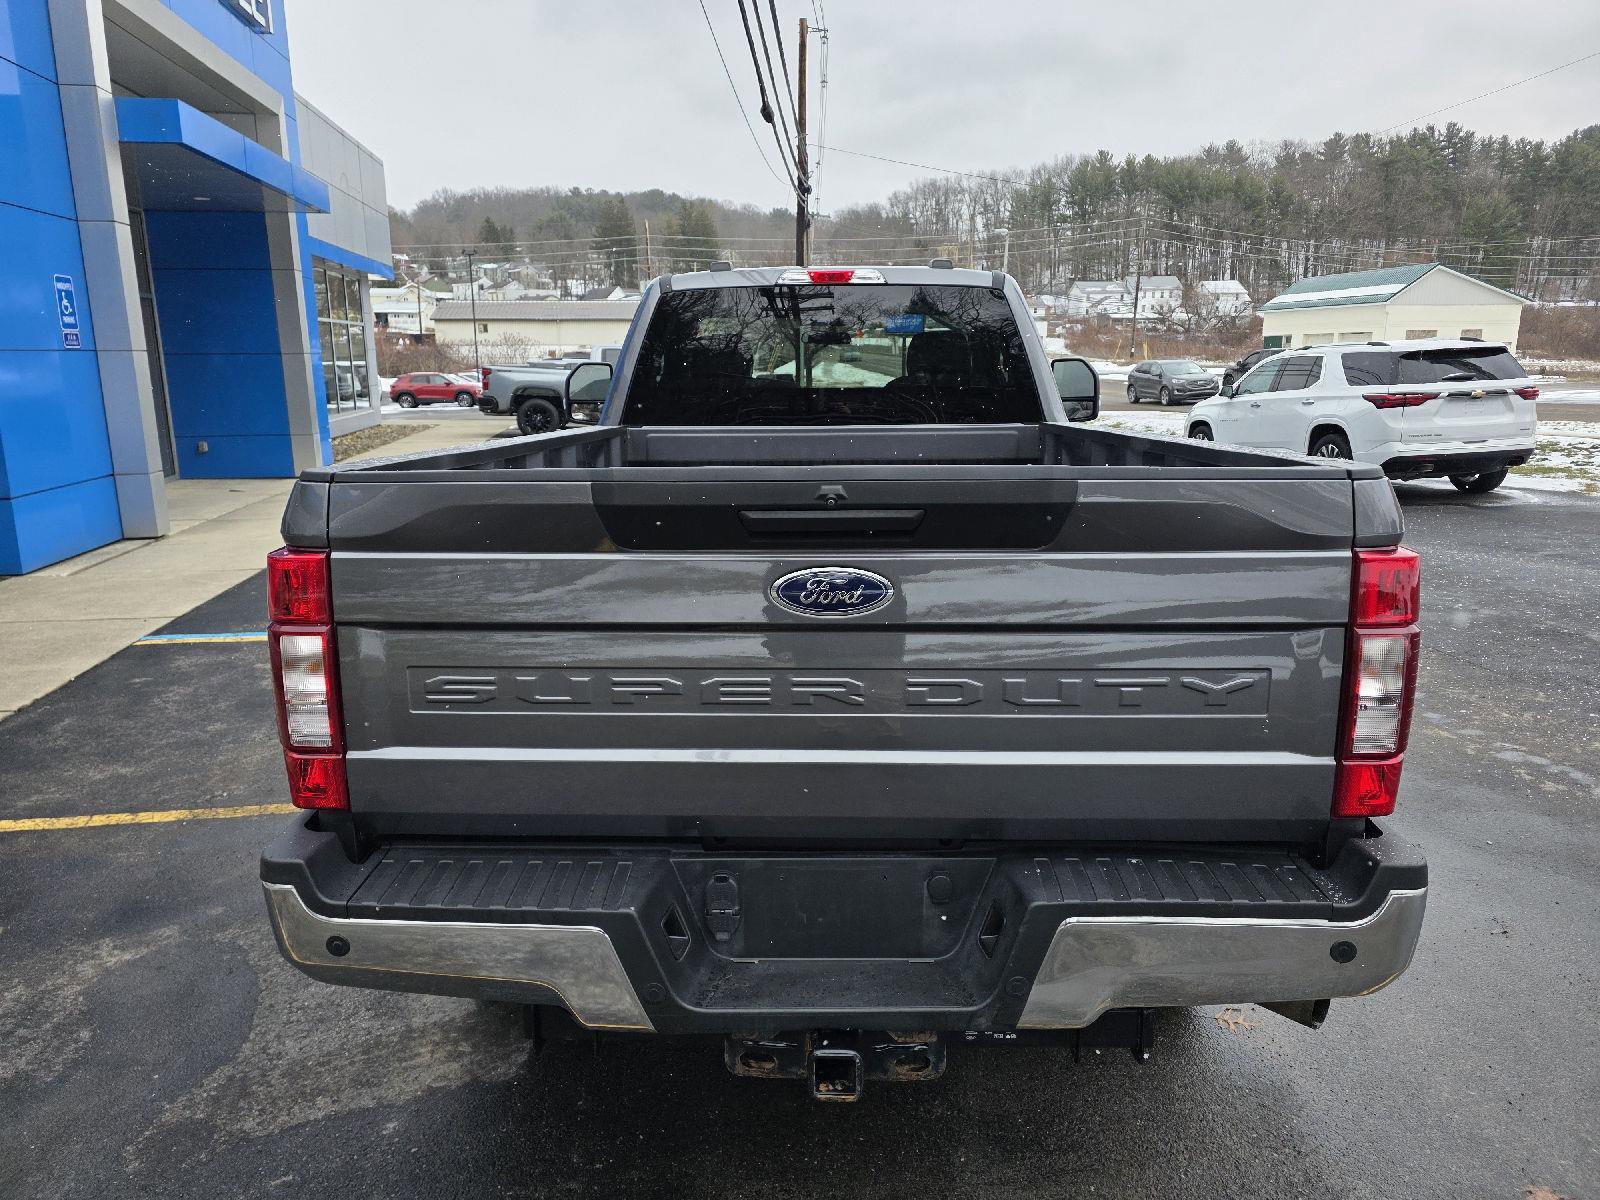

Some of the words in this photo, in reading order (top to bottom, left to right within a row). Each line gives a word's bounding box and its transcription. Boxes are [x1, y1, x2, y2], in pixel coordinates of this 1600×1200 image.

[800, 577, 865, 604] Ford
[424, 676, 865, 706] SUPER
[905, 677, 1256, 707] DUTY
